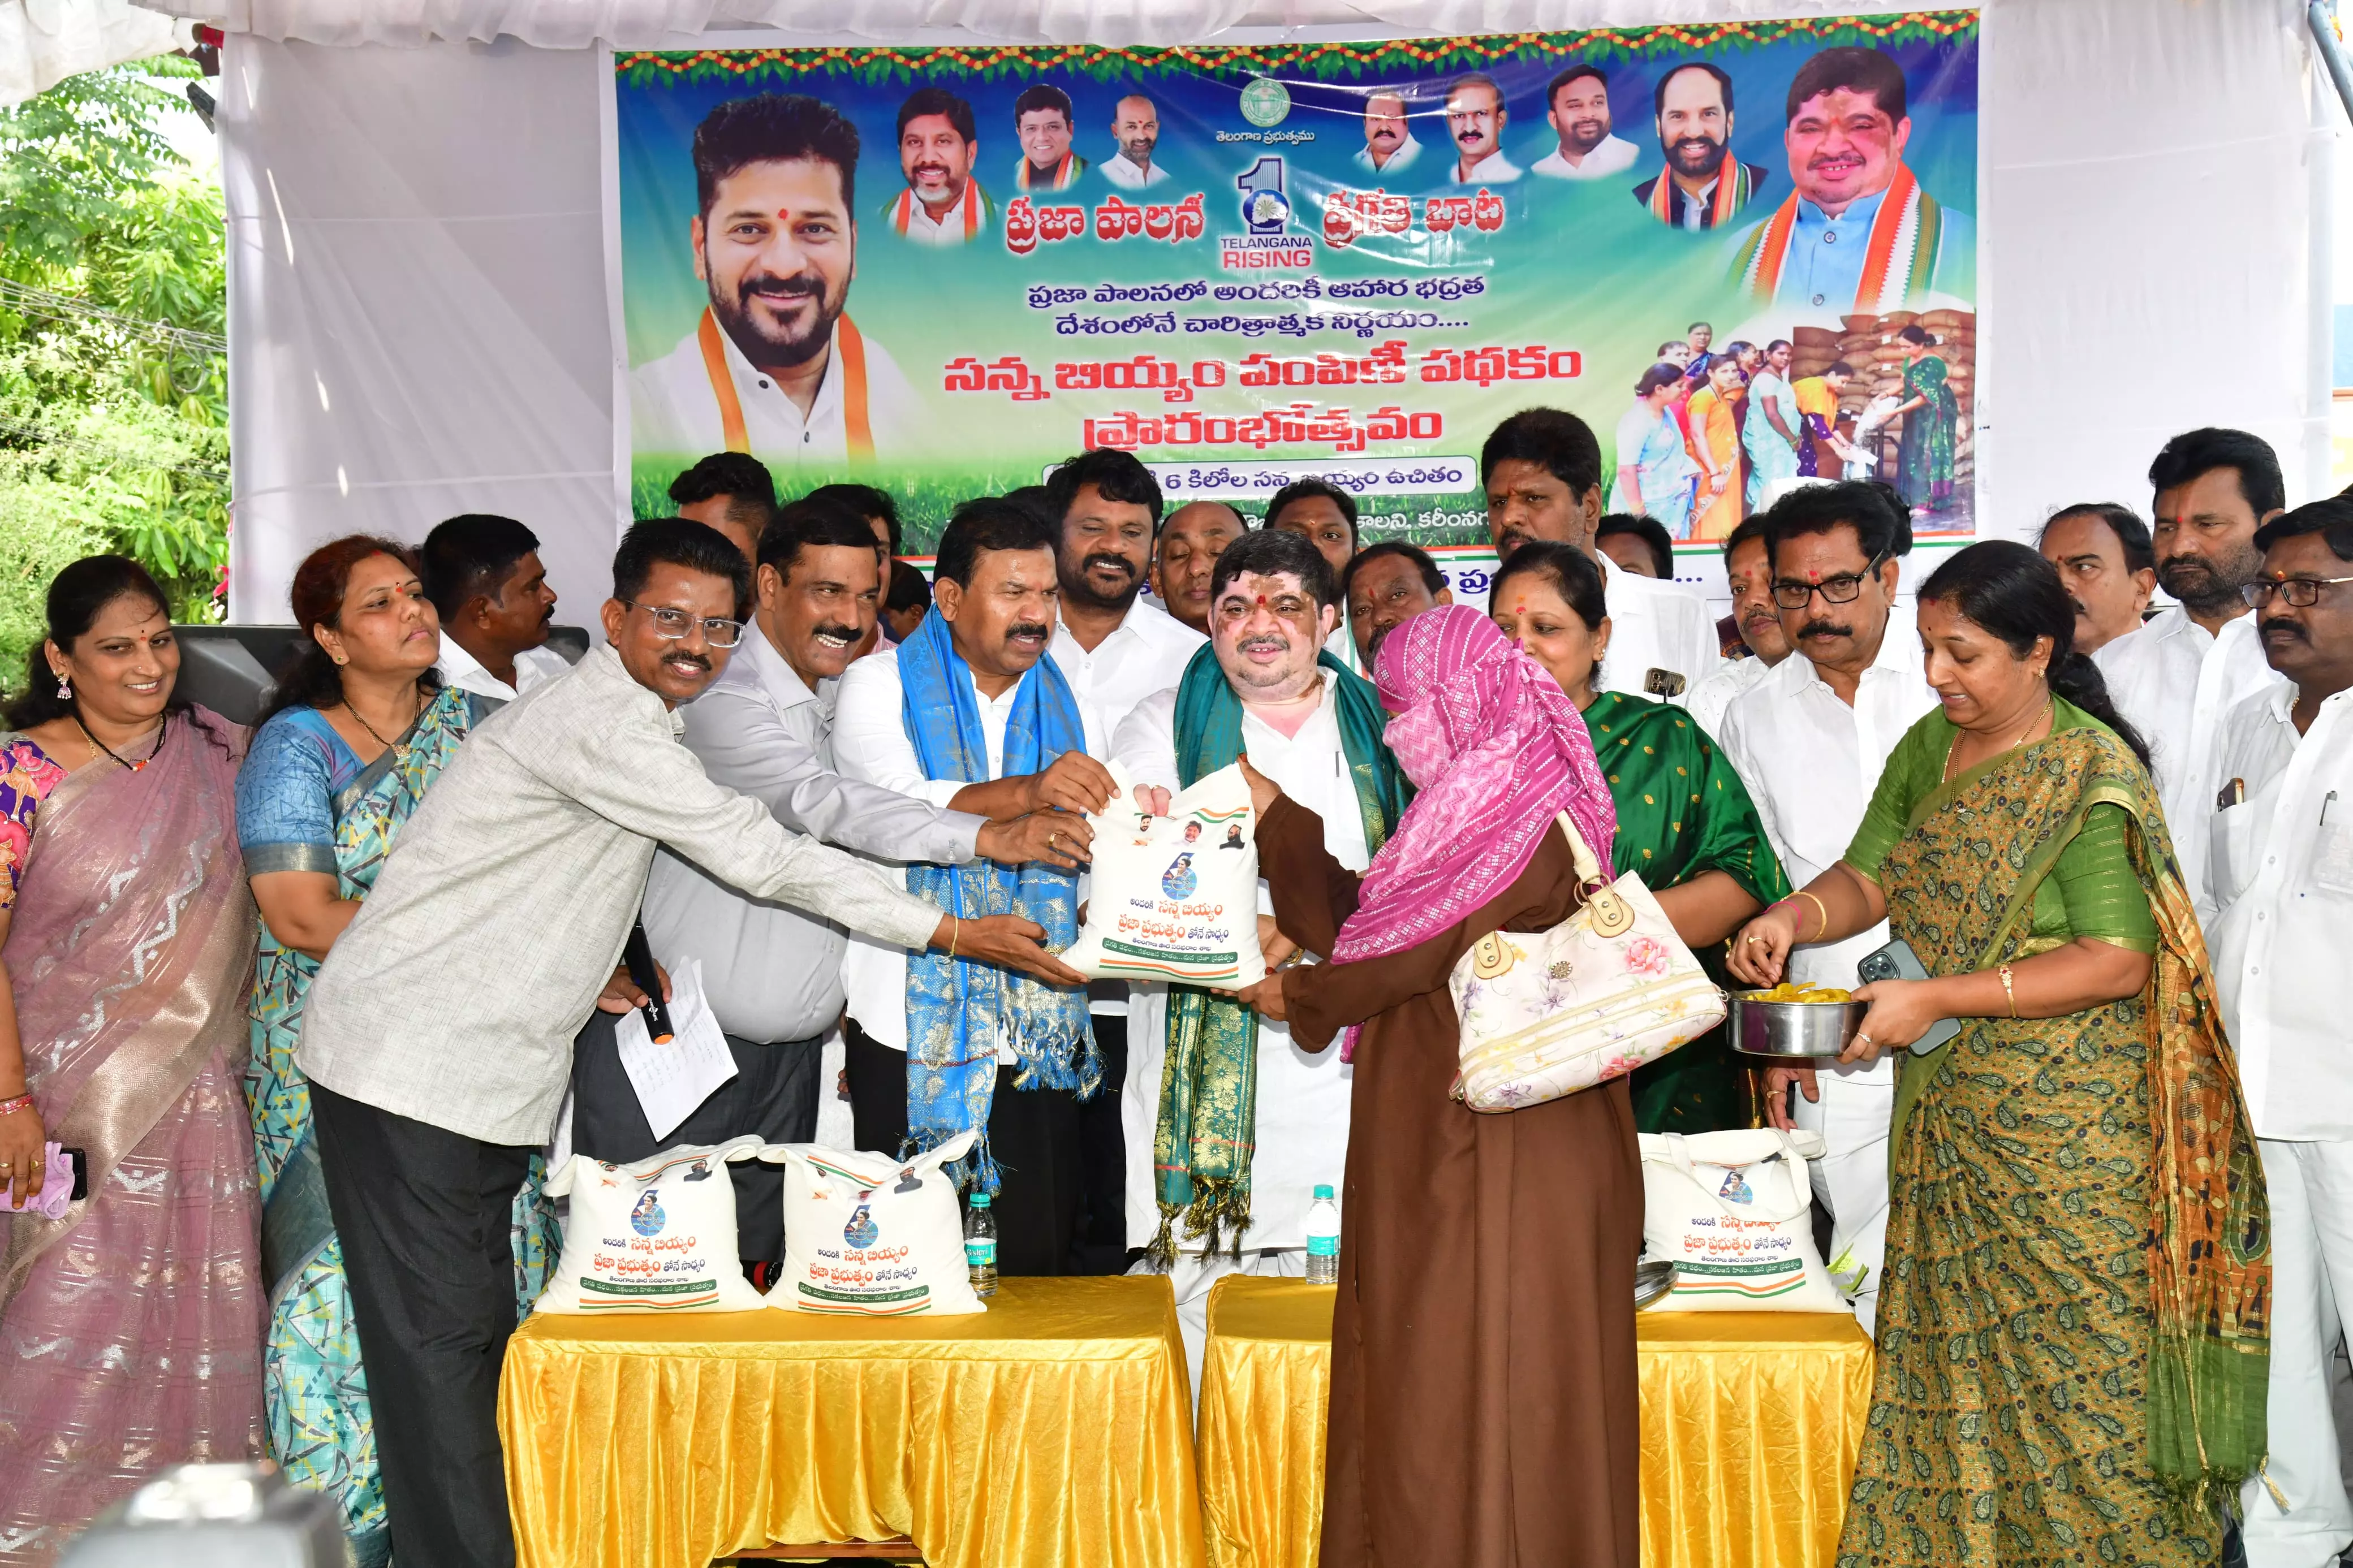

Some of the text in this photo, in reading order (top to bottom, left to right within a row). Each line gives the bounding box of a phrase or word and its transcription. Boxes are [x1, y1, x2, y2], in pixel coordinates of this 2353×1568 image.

[1216, 130, 1315, 145] తెలంగాణ ప్రభుత్వము
[1007, 192, 1205, 254] ప్రజా పాలన
[1221, 237, 1312, 249] TELANGANA
[1223, 250, 1311, 269] RISING
[1028, 275, 1485, 308] ప్రజా పాలనలో అందరికీ ఆహార భద్రత
[1055, 311, 1176, 335] దేశంలోనే
[1183, 312, 1325, 337] చారిత్రాత్మక
[945, 340, 1581, 403] సన్న బియ్యం పంపిణీ పథకం
[1084, 403, 1442, 452] ప్రారంభోత్సవం
[1165, 474, 1181, 489] 6
[1187, 468, 1247, 488] కిలోల
[1386, 466, 1462, 484] ఉచితం
[1419, 507, 1489, 528] కరీంనగ
[1158, 900, 1180, 919] సన్న
[1182, 903, 1222, 921] బియ్యం
[1118, 914, 1229, 943] ప్రజా ప్రభుత్వం తోనే సాధ్యం
[1721, 1215, 1743, 1232] సన్న
[631, 1237, 654, 1255] సన్న
[655, 1236, 696, 1254] బియ్యం
[844, 1249, 866, 1265] సన్న
[868, 1246, 908, 1263] బియ్యం
[1684, 1234, 1791, 1255] ప్రజా ప్రభుత్వం తోనే సాధ్యం
[594, 1252, 705, 1277] ప్రజా ప్రభుత్వం తోనే సాధ్యం
[809, 1263, 917, 1286] ప్రజా ప్రభుత్వం తోనే సాధ్యం
